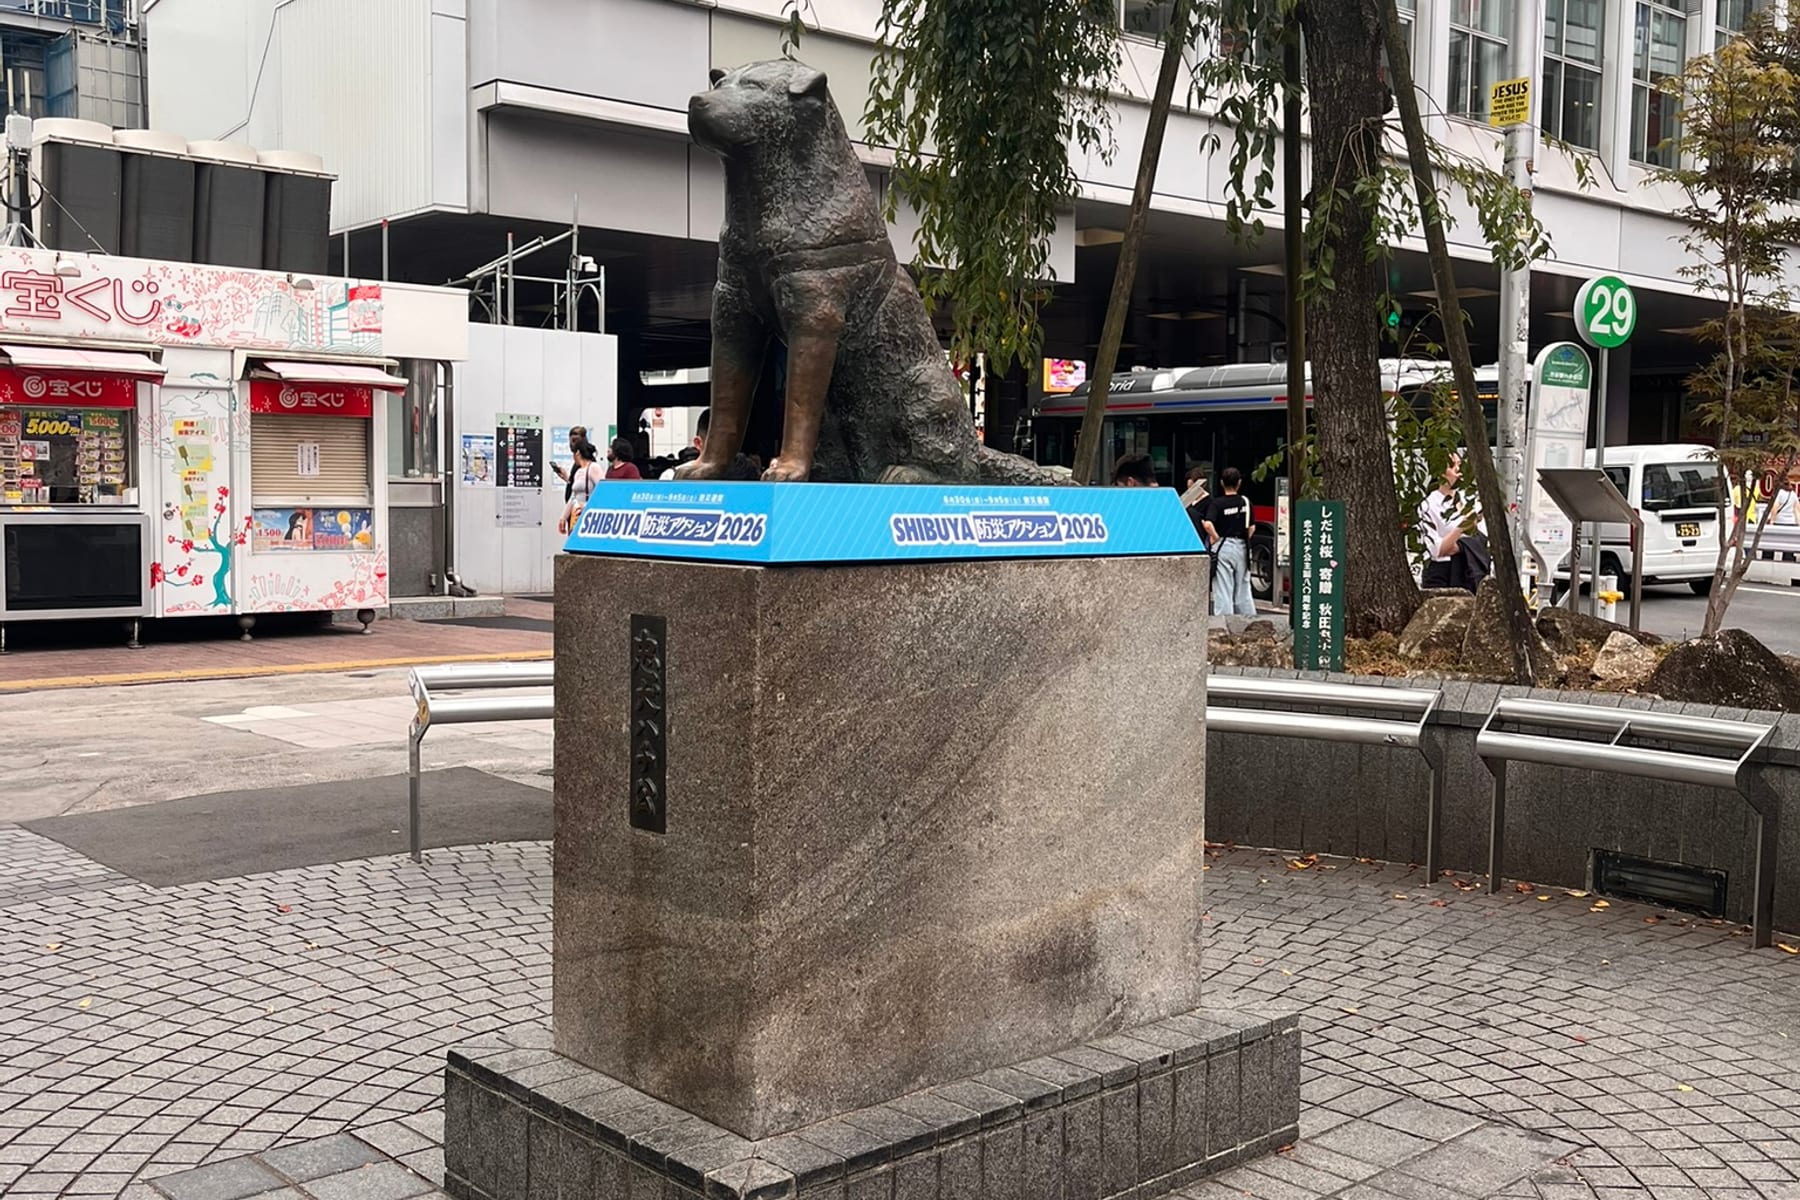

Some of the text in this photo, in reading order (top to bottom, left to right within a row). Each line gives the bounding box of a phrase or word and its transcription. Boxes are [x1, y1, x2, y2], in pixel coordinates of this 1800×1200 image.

[1492, 81, 1528, 99] JESUS
[2, 269, 161, 325] 宝くじ
[1590, 285, 1633, 336] 29
[49, 379, 102, 397] 宝くじ
[300, 391, 345, 408] 宝くじ
[580, 511, 765, 542] SHIBUYA 防災アクション 2026
[893, 516, 1106, 542] SHIBUYA 防災アクション 2026
[1319, 505, 1333, 559] しだれ桜
[1319, 567, 1333, 594] 寄贈
[633, 628, 662, 816] 忠犬ハチ公
